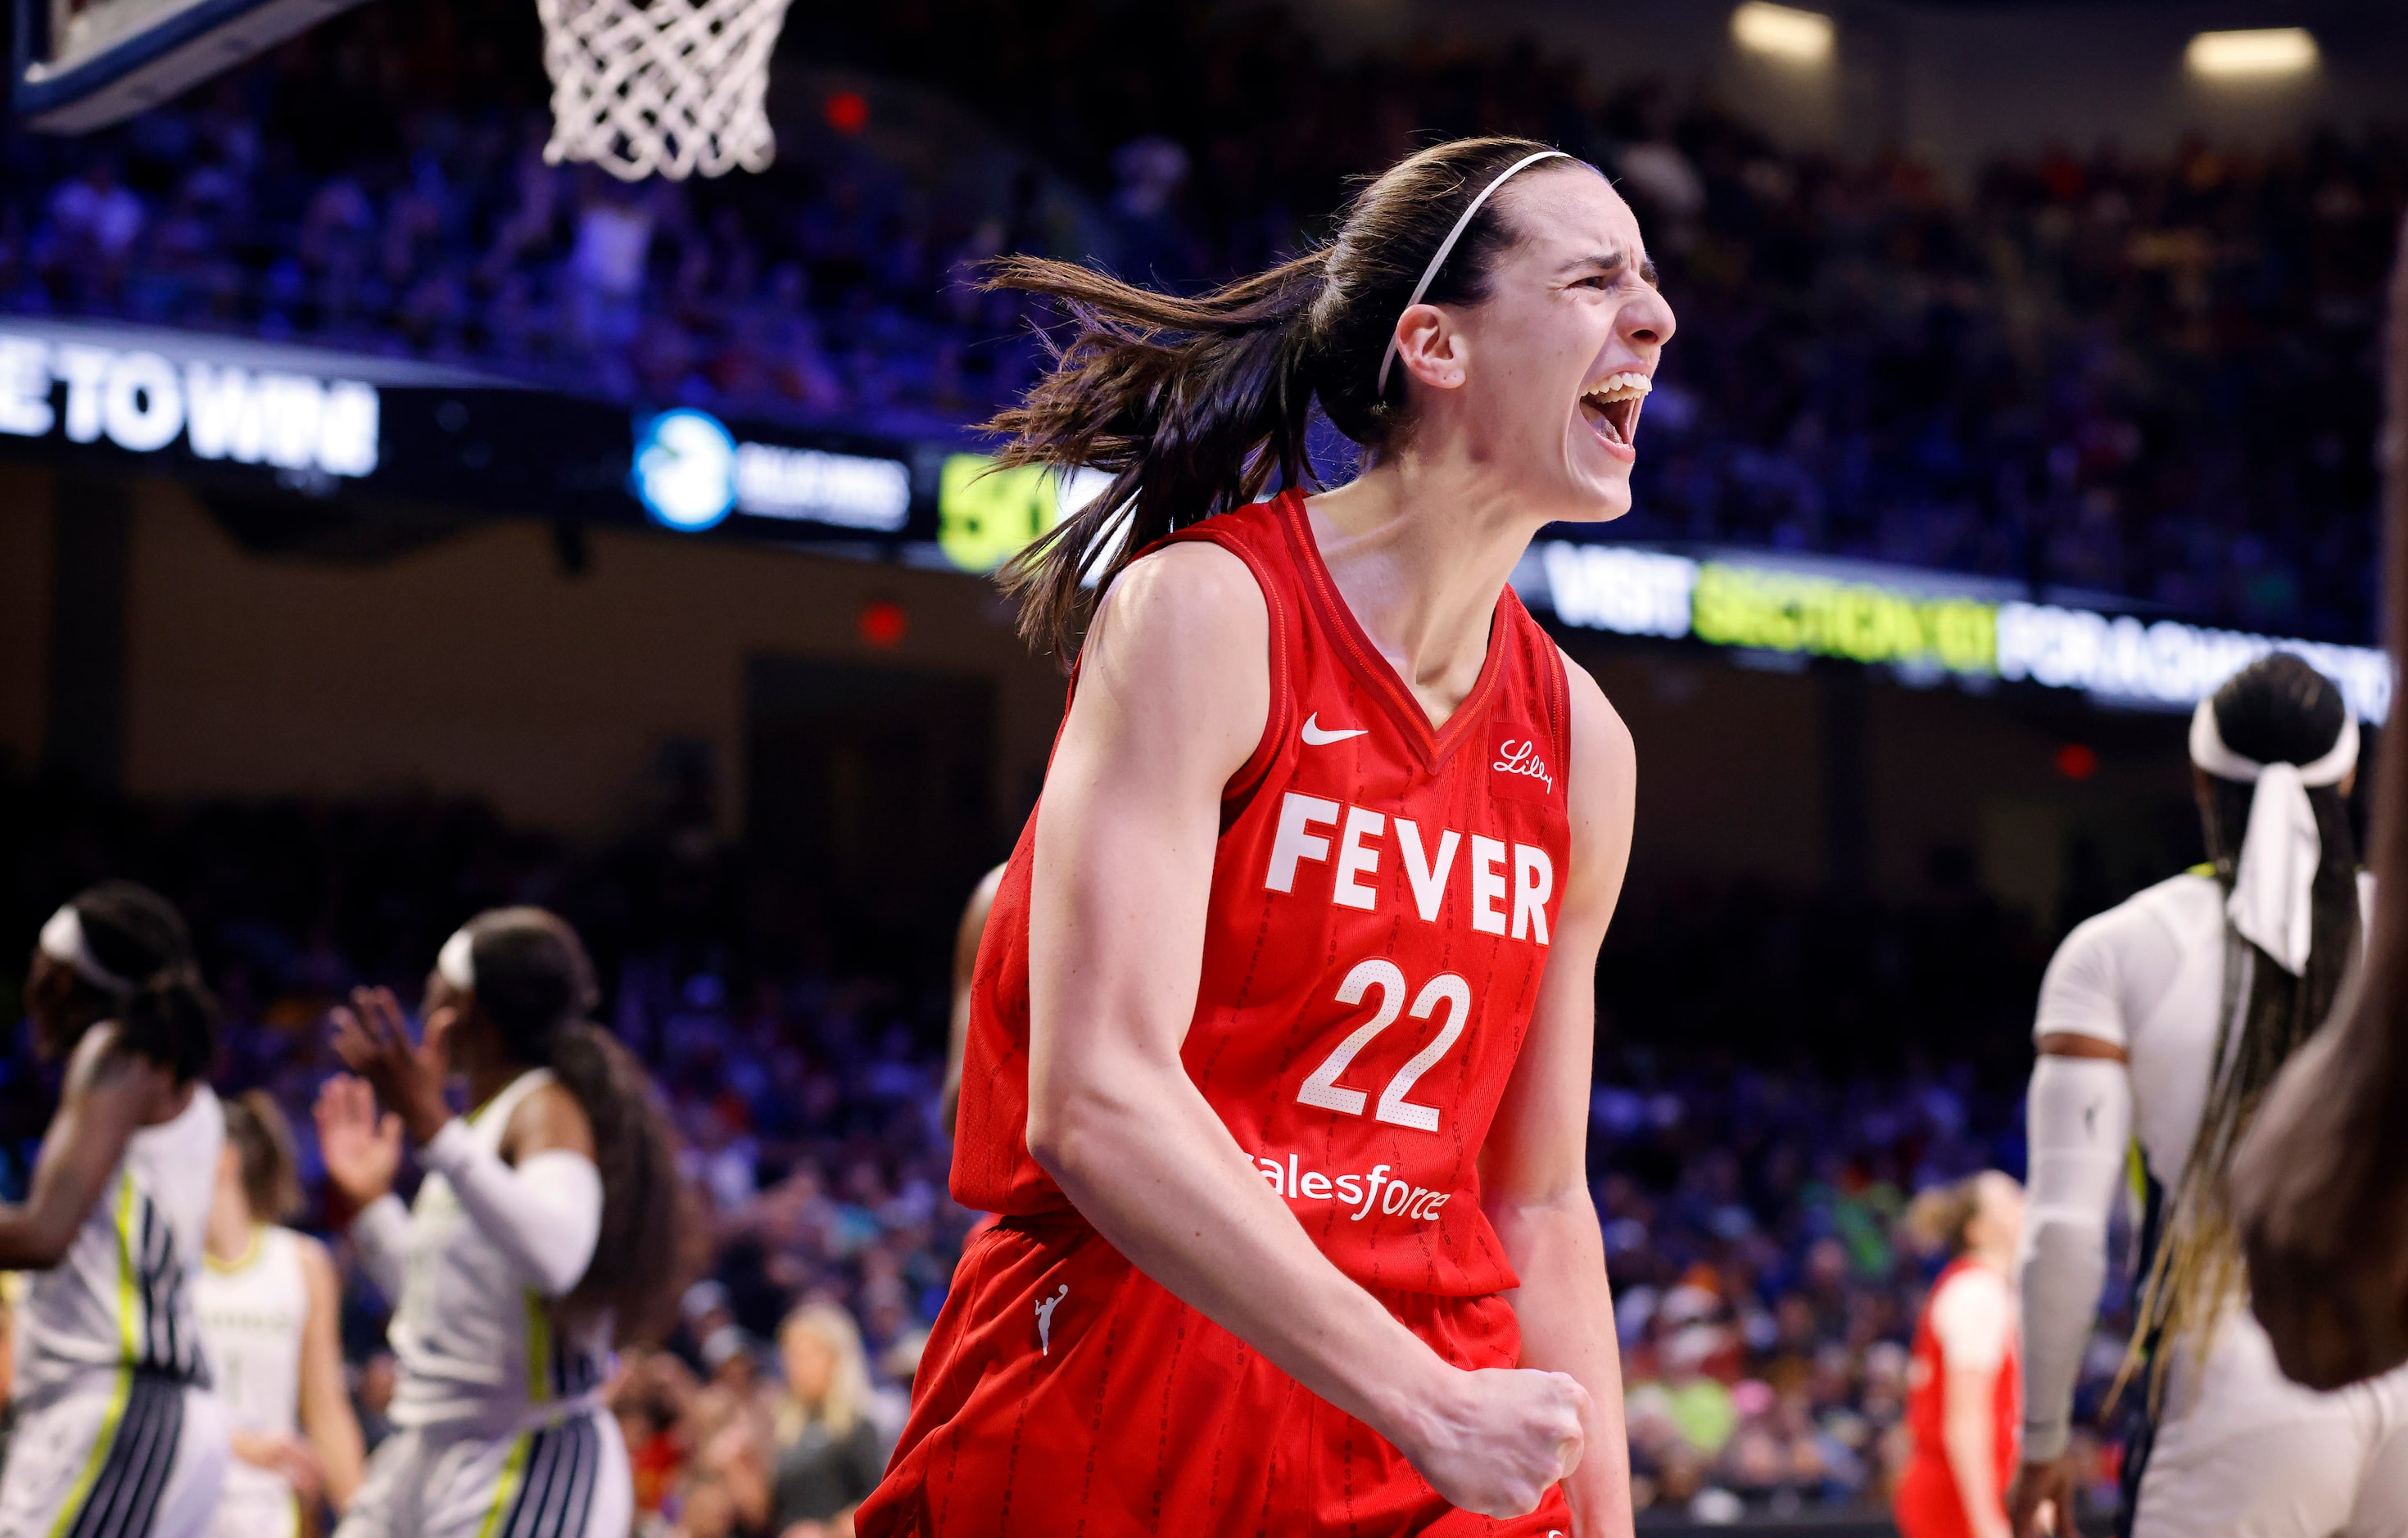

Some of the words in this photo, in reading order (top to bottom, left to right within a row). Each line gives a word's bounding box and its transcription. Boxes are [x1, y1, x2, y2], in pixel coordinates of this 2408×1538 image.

[56, 341, 183, 453] TO
[1493, 739, 1553, 795] Lilly
[1264, 791, 1553, 946] FEVER
[1296, 959, 1472, 1133] 22
[1242, 1152, 1451, 1222] alesforce
[1156, 1327, 1185, 1479] BASKETBALL
[999, 1397, 1027, 1538] BASKETBAL
[1080, 1444, 1097, 1505] 2012
